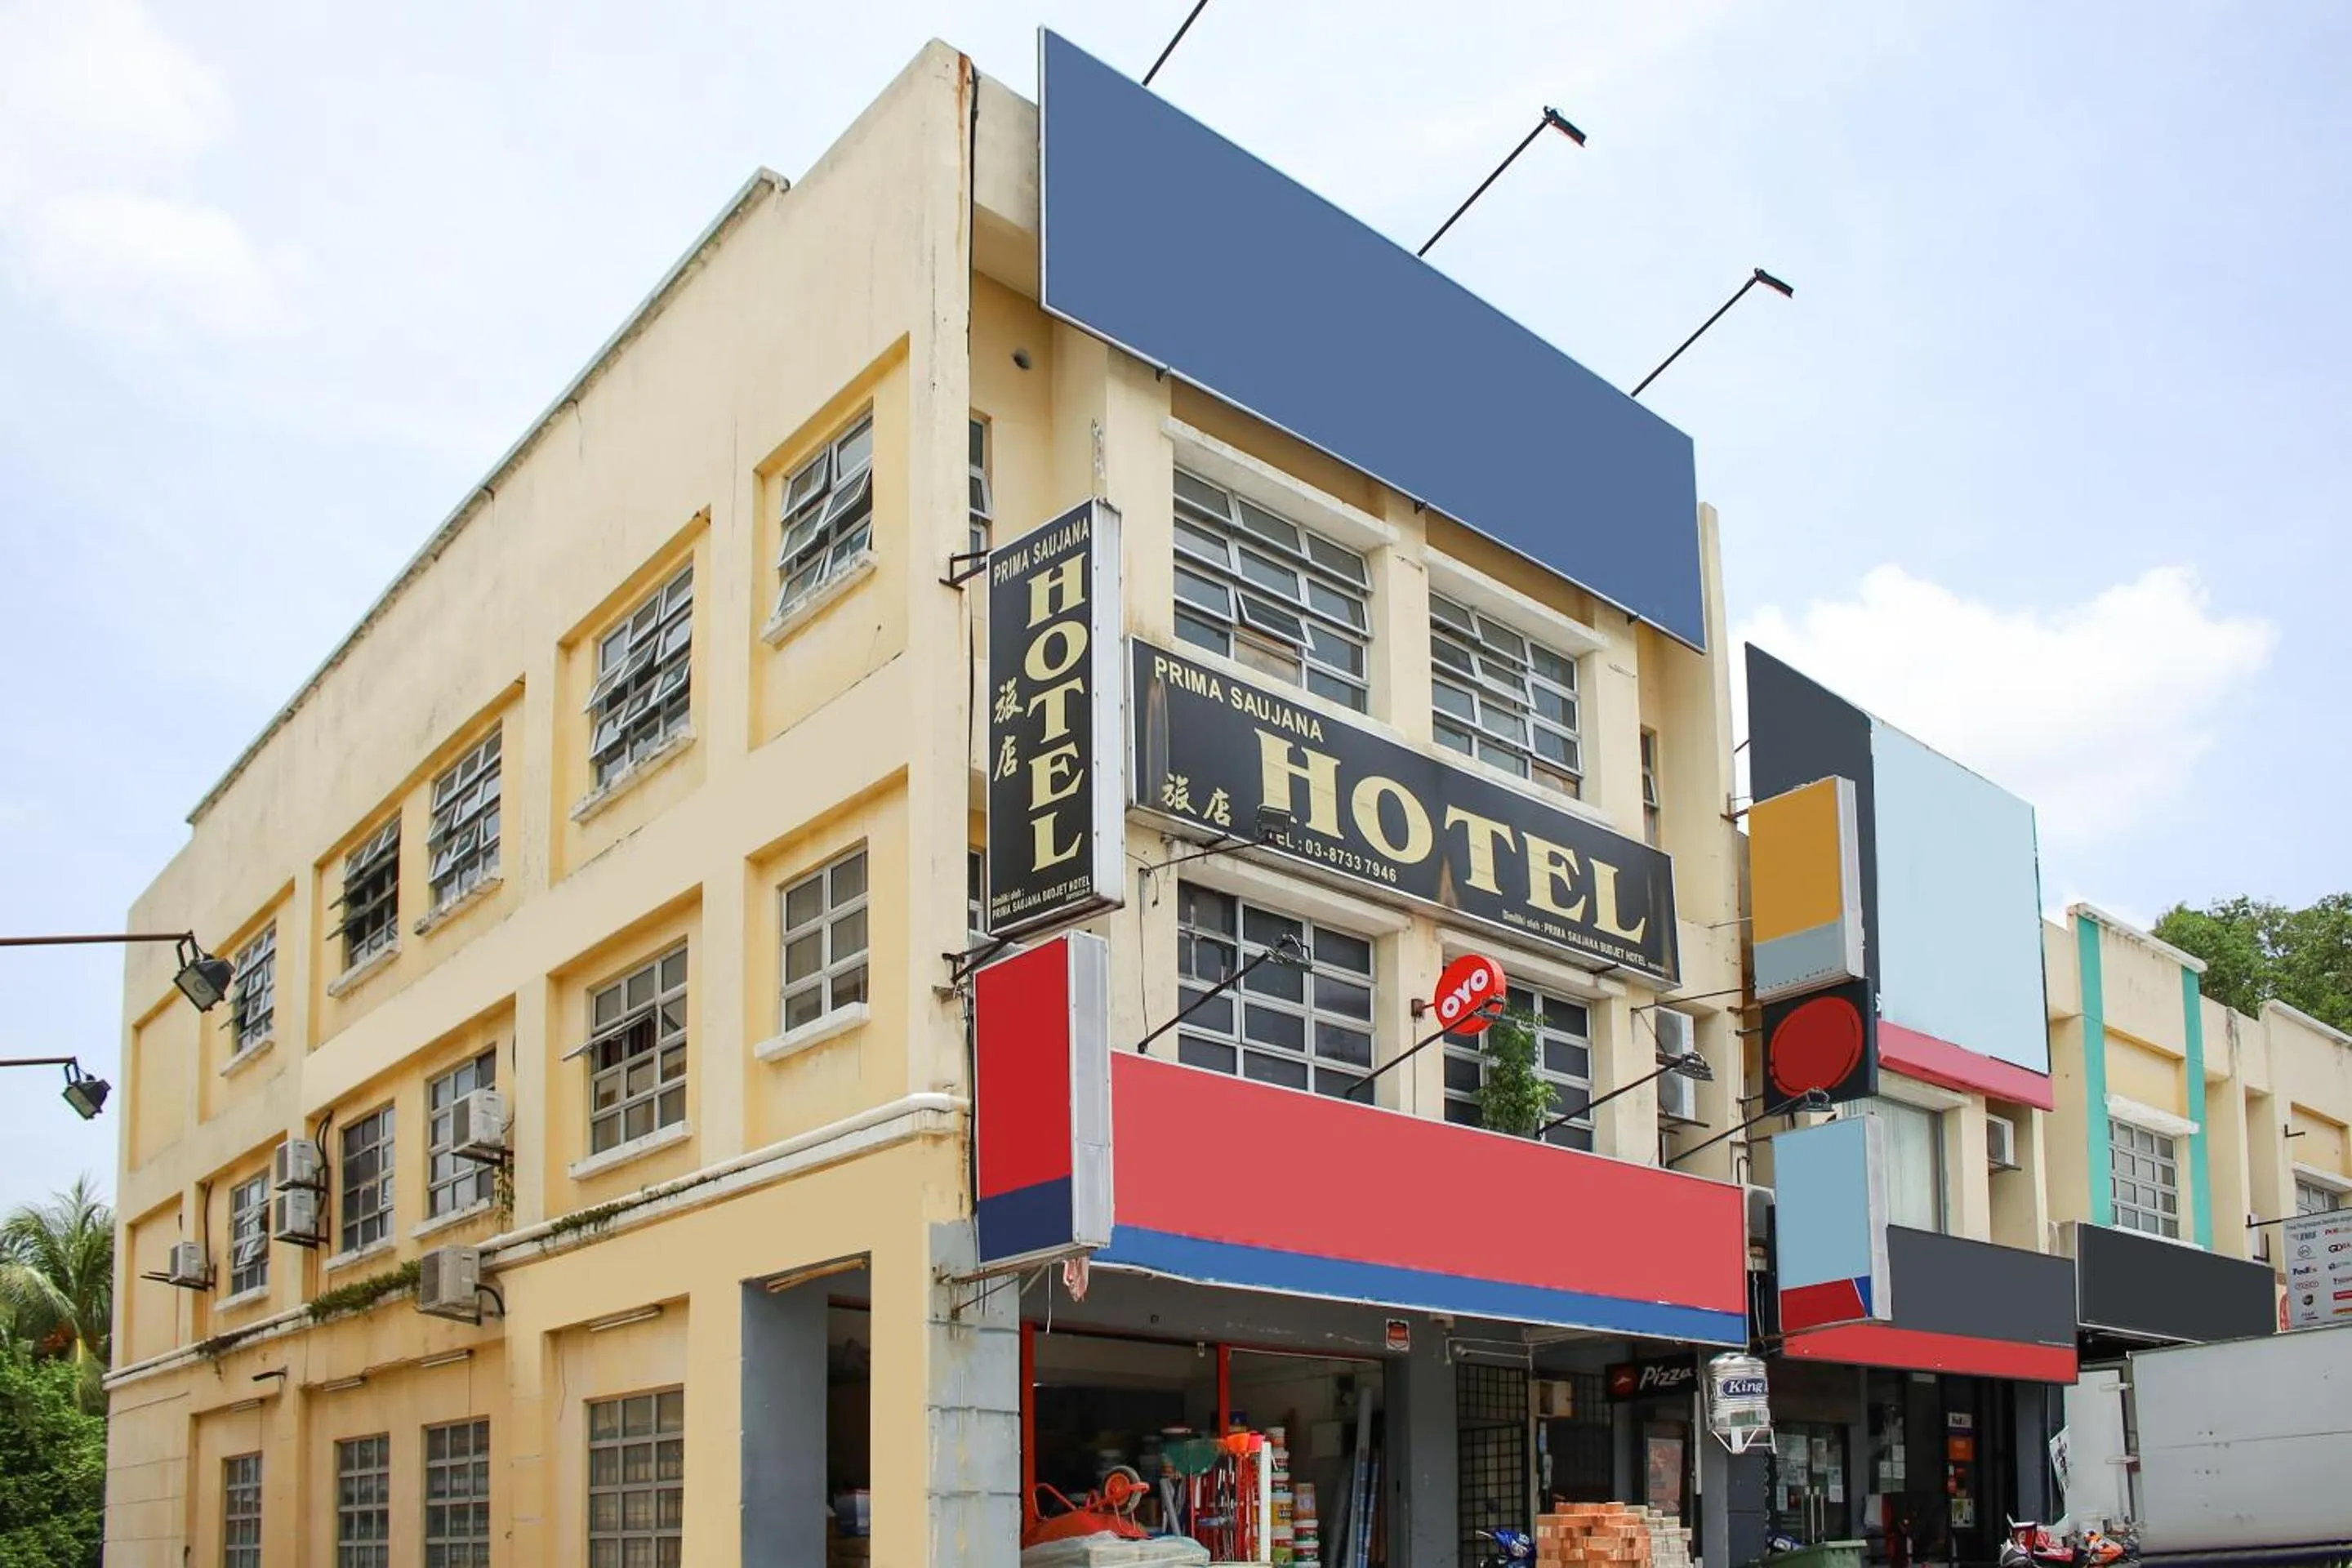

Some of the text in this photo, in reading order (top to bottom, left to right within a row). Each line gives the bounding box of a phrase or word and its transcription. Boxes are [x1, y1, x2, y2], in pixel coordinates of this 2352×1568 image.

[994, 517, 1089, 587] PRIMA SAUJANA
[1024, 551, 1089, 872] HOTEL
[1155, 656, 1324, 742] PRIMA SAUJANA
[1254, 727, 1647, 945] HOTEL
[1305, 839, 1362, 871] 03-8733
[1365, 858, 1397, 883] 7946
[1626, 950, 1647, 967] HOTEL
[1441, 969, 1489, 1018] OYO
[1640, 1365, 1693, 1389] Pizza
[1729, 1379, 1763, 1393] King
